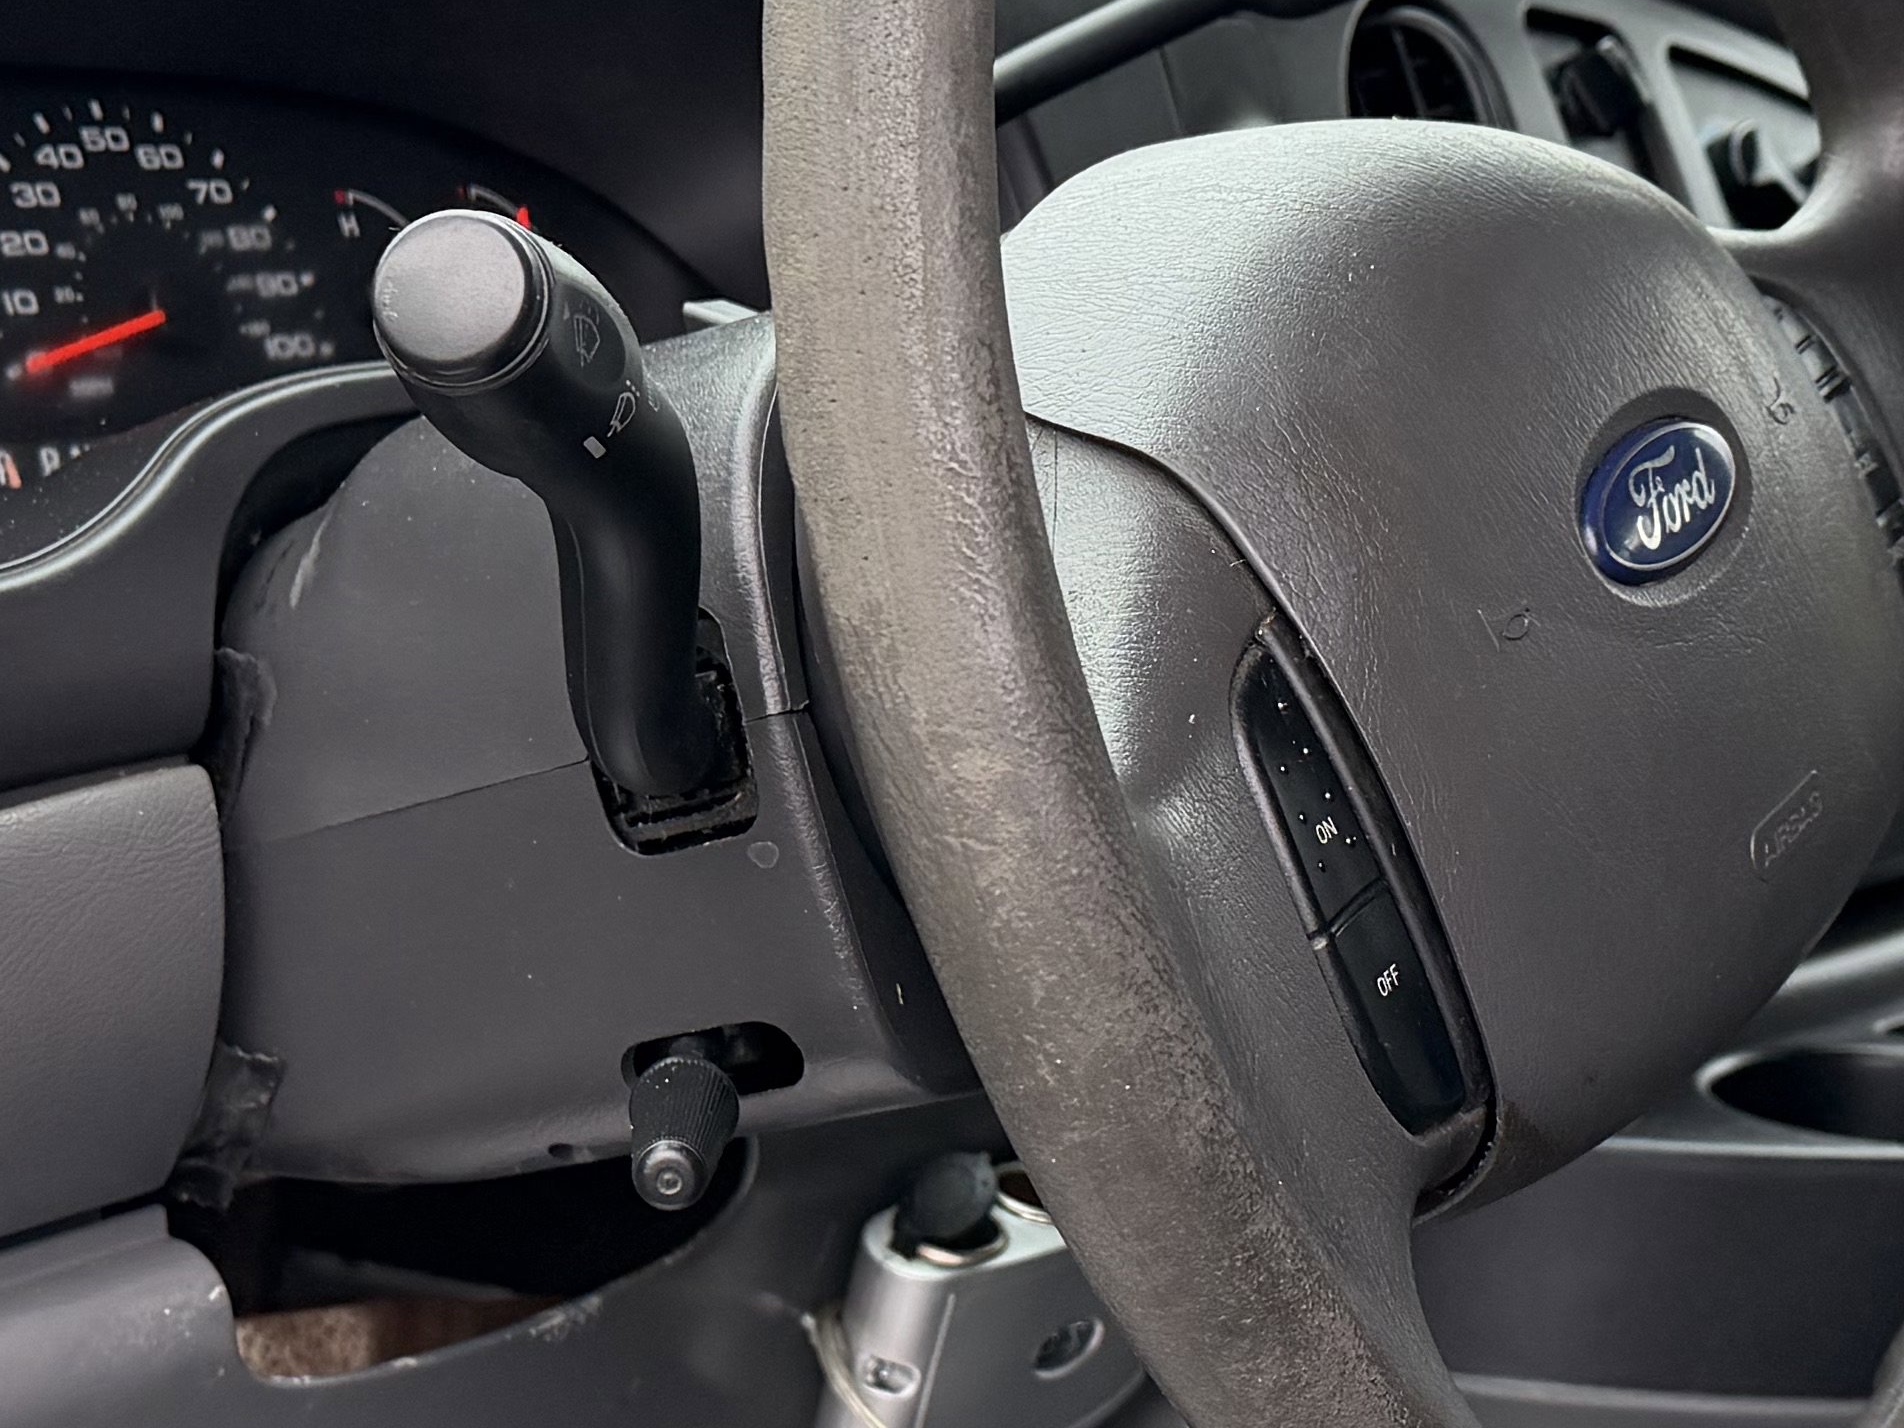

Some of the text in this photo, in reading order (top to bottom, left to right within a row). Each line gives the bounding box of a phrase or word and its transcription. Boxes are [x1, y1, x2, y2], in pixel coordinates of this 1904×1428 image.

[79, 126, 130, 152] 50
[34, 144, 85, 169] 40
[135, 144, 184, 170] 60
[10, 181, 61, 208] 30
[186, 178, 233, 204] 70
[227, 225, 272, 251] 80
[338, 213, 360, 237] H
[0, 229, 49, 257] 20
[255, 272, 299, 298] 90
[2, 288, 40, 316] 10
[264, 333, 316, 360] 100
[1628, 445, 1715, 550] Ford
[1315, 816, 1338, 844] ON
[1376, 963, 1399, 997] OFF
